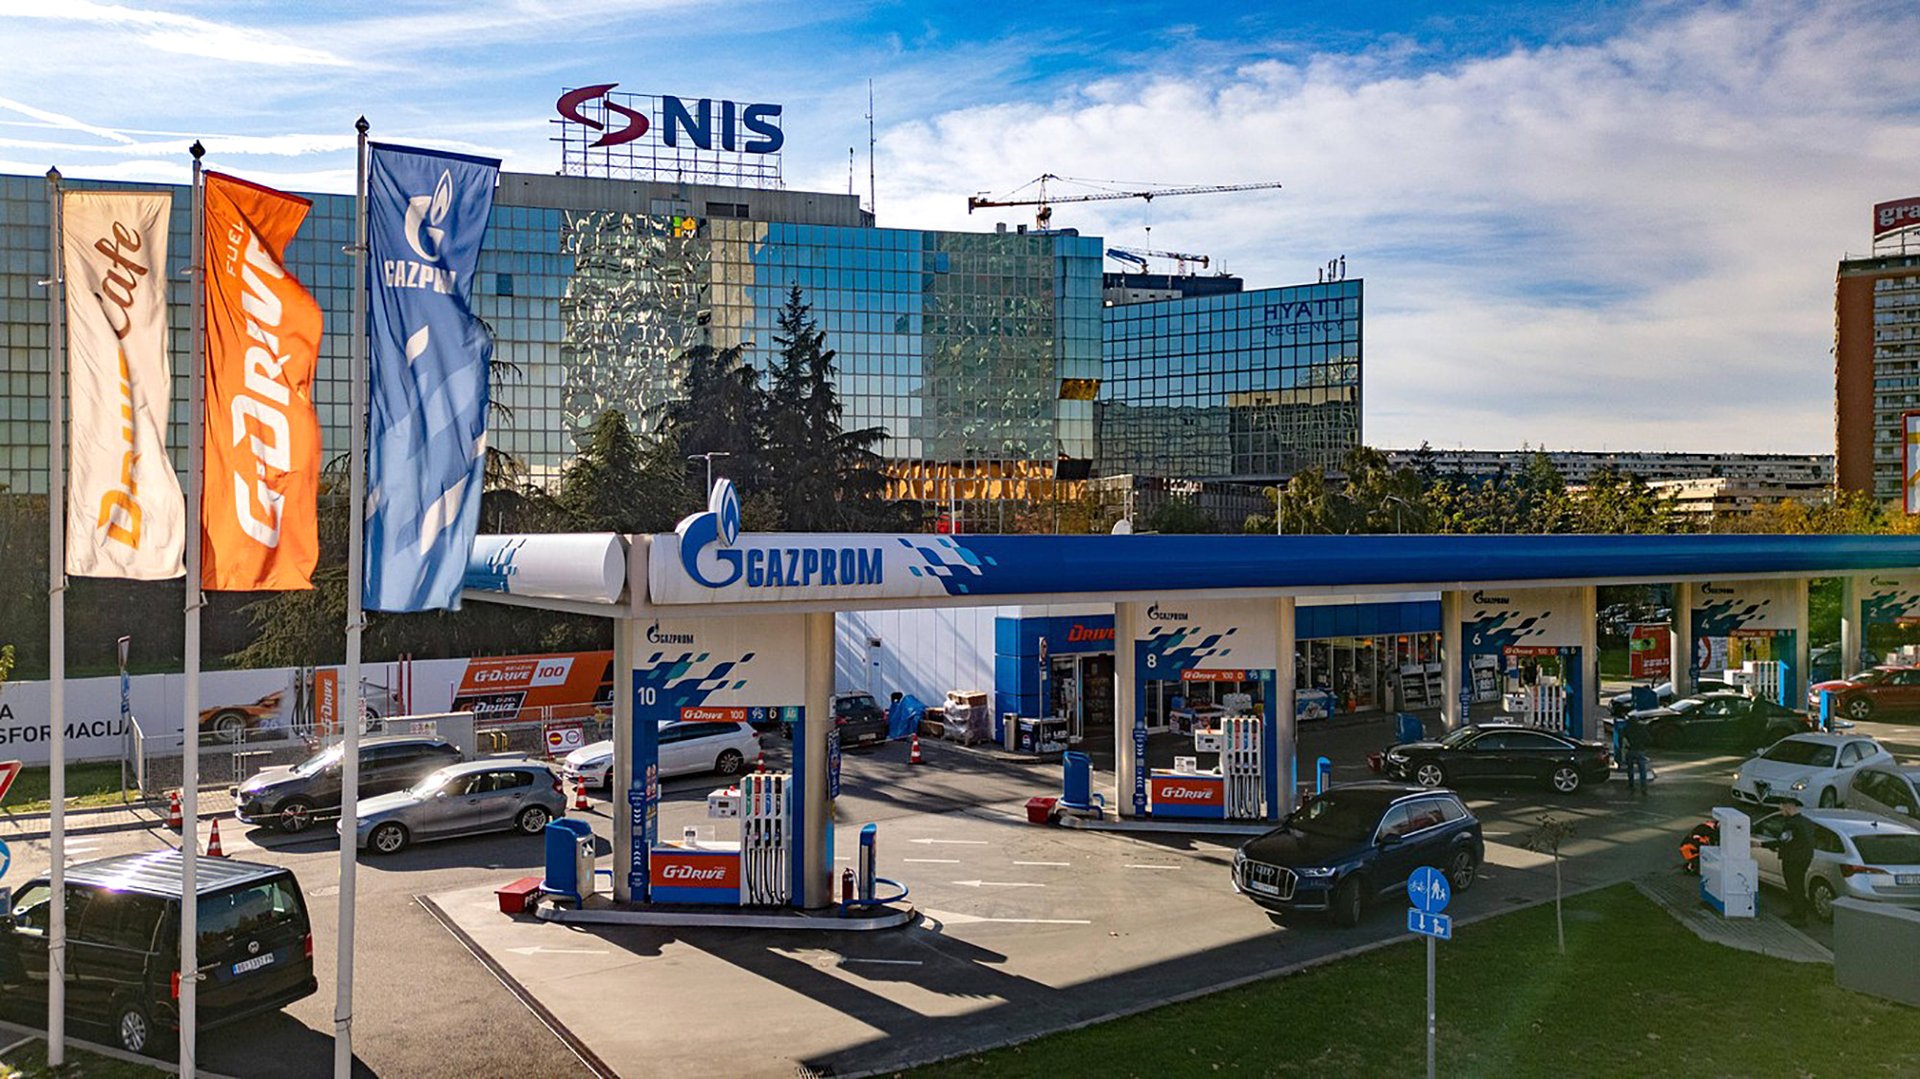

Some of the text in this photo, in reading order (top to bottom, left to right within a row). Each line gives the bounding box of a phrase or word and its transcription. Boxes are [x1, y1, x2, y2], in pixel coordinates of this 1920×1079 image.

[663, 95, 784, 154] NIS
[1264, 299, 1344, 321] HYATT
[1265, 320, 1344, 338] REGENCY
[747, 547, 883, 588] GAZPROM
[660, 633, 694, 644] GAZPROM
[1068, 624, 1115, 642] DRIVE
[1472, 633, 1482, 645] 6
[1147, 654, 1157, 668] 8
[538, 666, 565, 678] 100
[638, 687, 656, 705] 10
[730, 710, 744, 719] 100
[752, 711, 763, 719] 95
